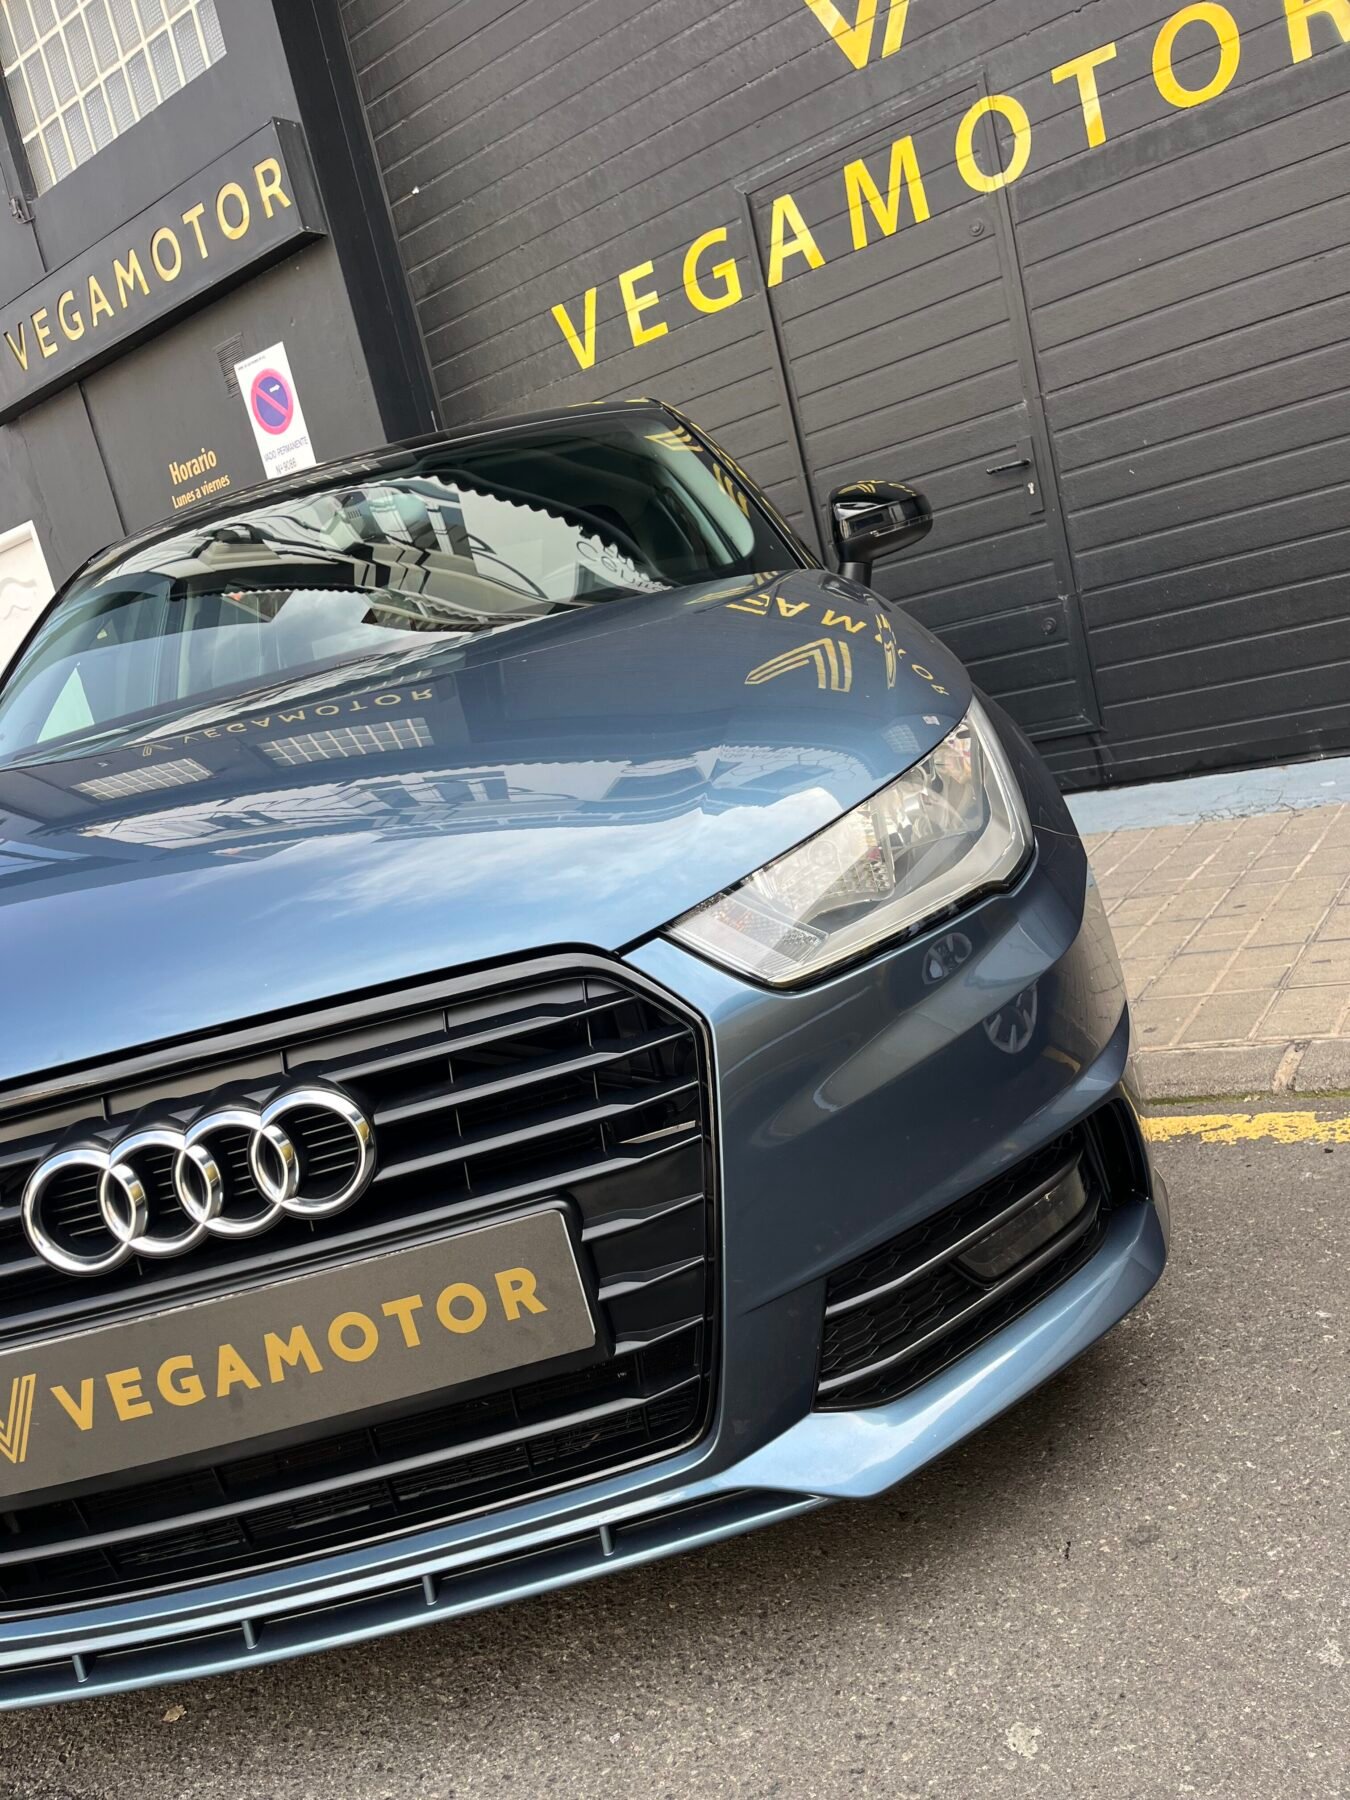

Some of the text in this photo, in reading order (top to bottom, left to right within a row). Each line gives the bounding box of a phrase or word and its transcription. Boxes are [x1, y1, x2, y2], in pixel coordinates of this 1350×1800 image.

[3, 157, 292, 370] VEGAMOTOR
[277, 436, 309, 456] PERMANENTE
[169, 448, 217, 485] Horario
[172, 491, 198, 509] Lunes
[201, 474, 230, 497] viernes
[50, 1267, 548, 1431] VEGAMOTOR
